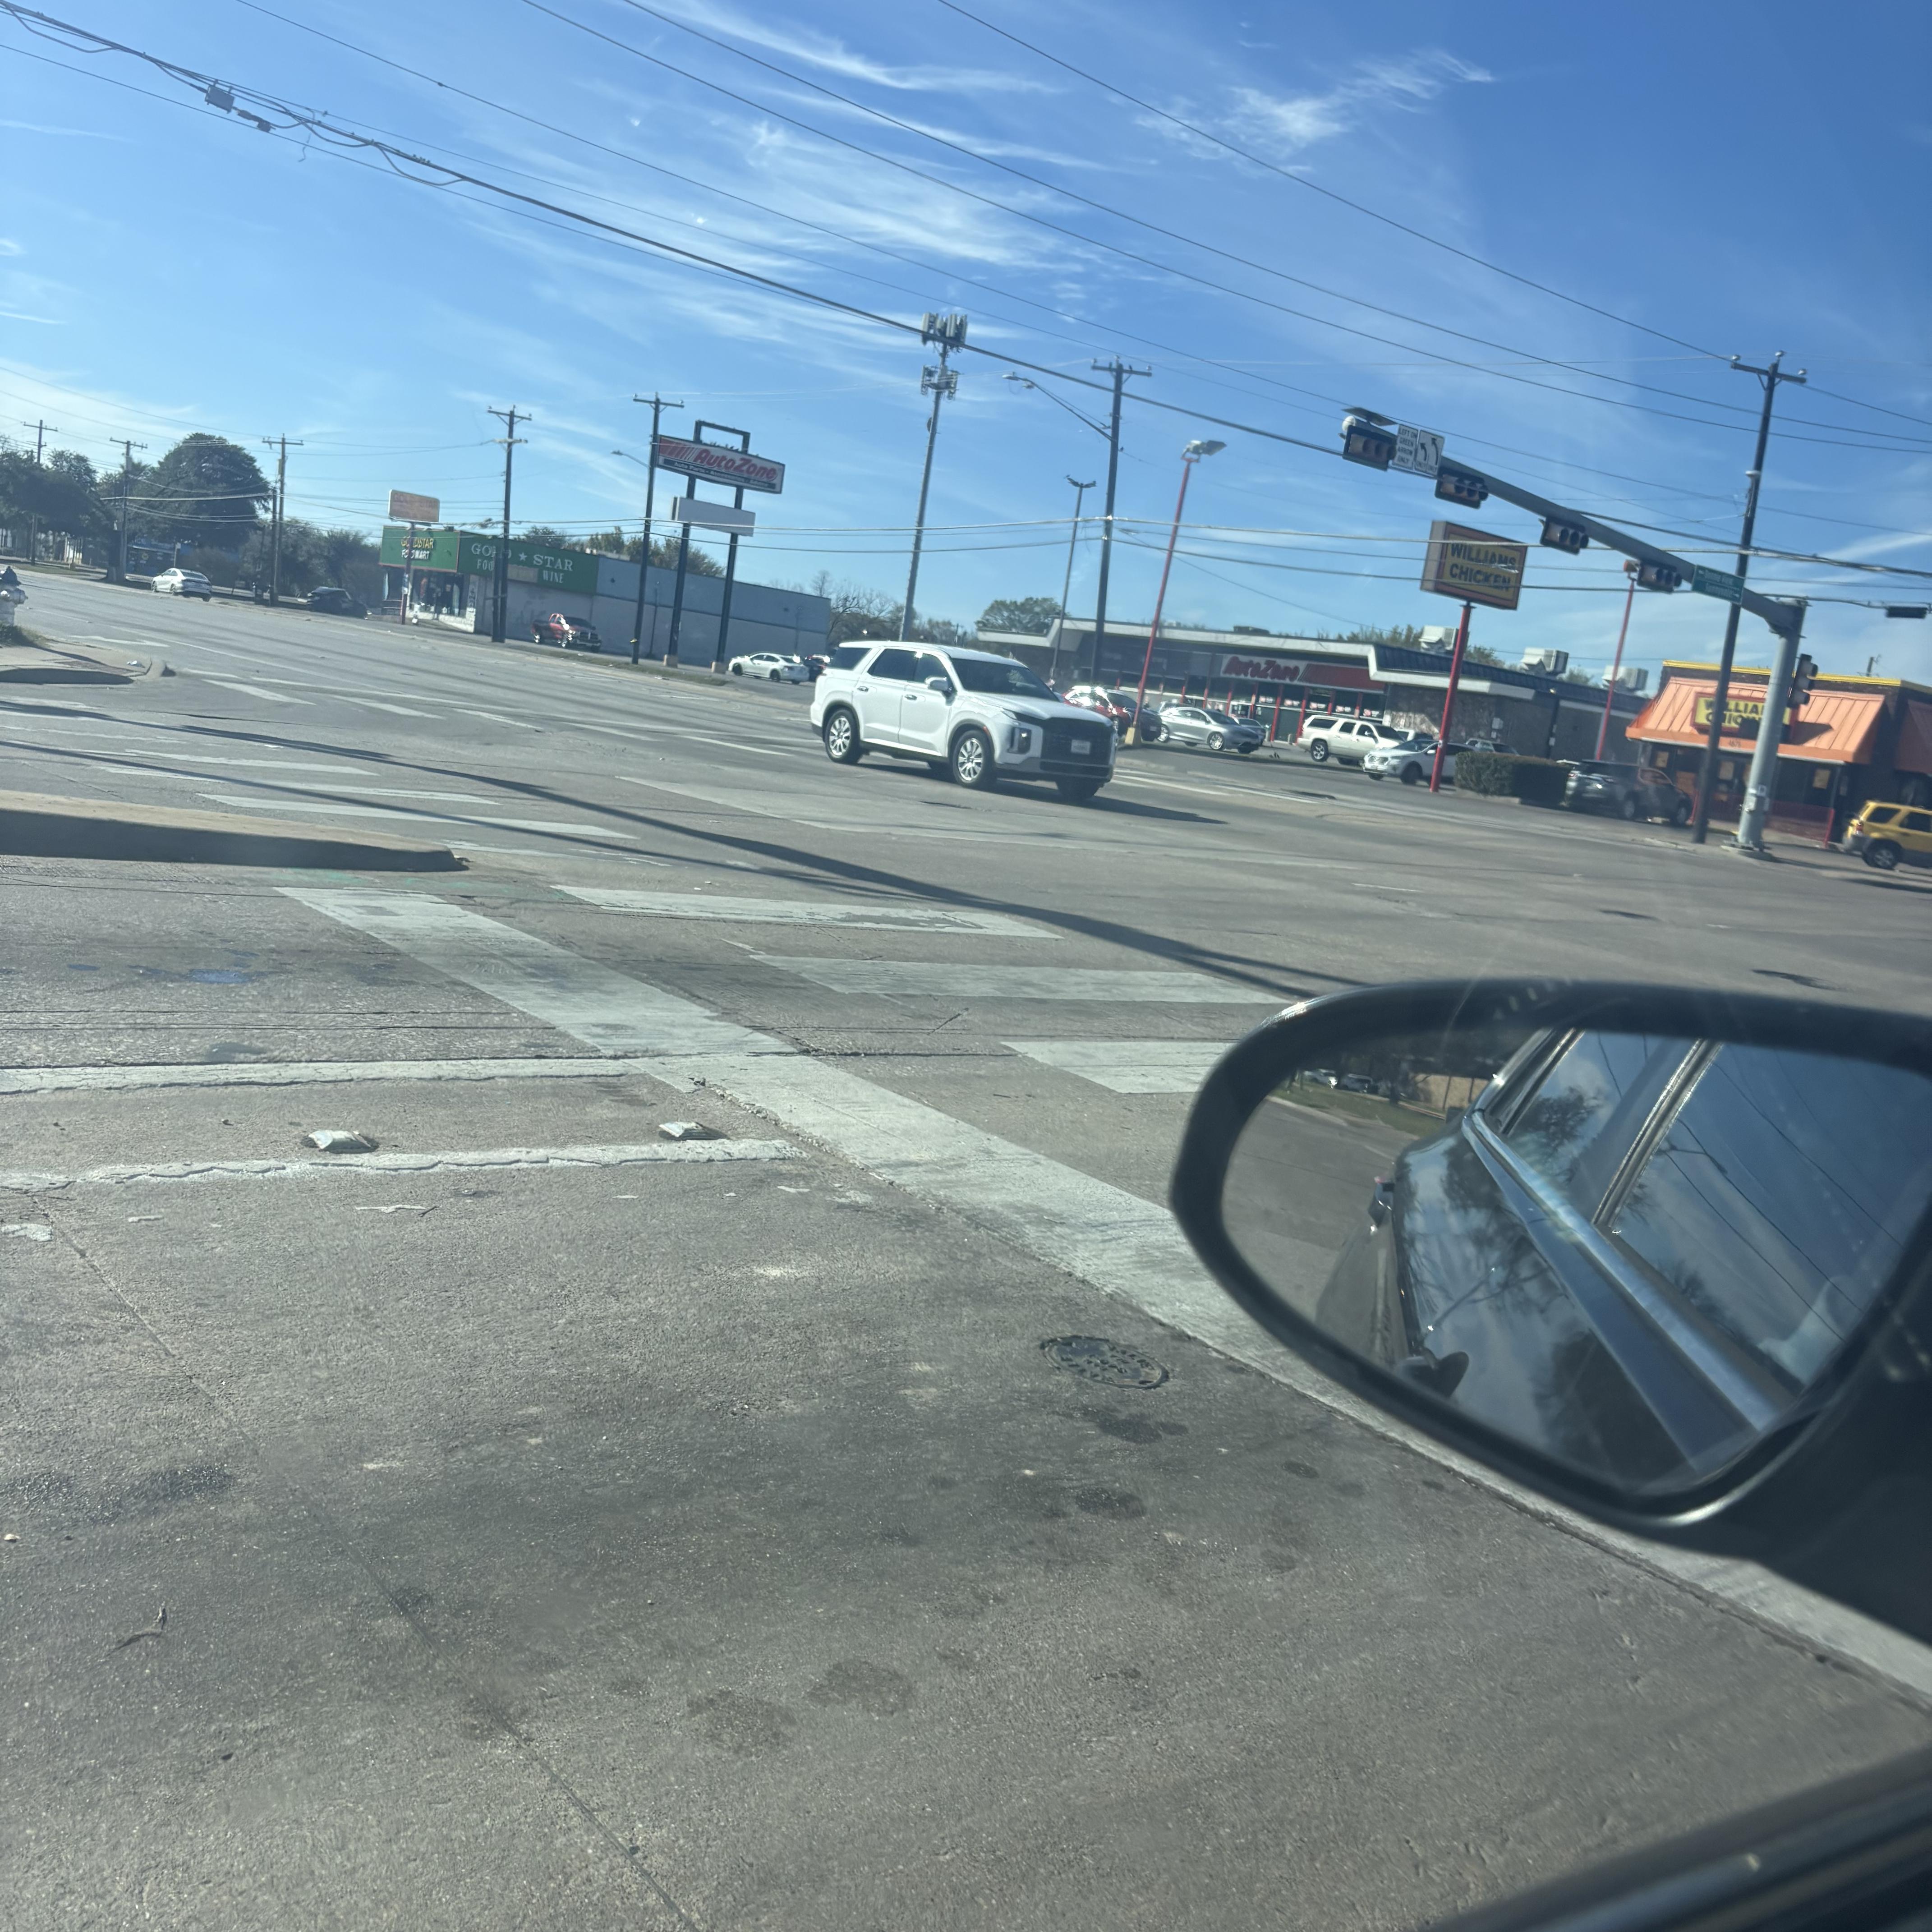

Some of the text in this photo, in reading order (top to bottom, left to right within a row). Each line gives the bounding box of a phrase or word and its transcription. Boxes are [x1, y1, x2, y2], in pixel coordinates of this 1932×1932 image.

[693, 449, 777, 481] AutoZone
[533, 554, 573, 571] STAR
[1450, 543, 1516, 570] WILLIAMS
[543, 570, 564, 583] WINE
[1449, 563, 1511, 591] CHICKEN
